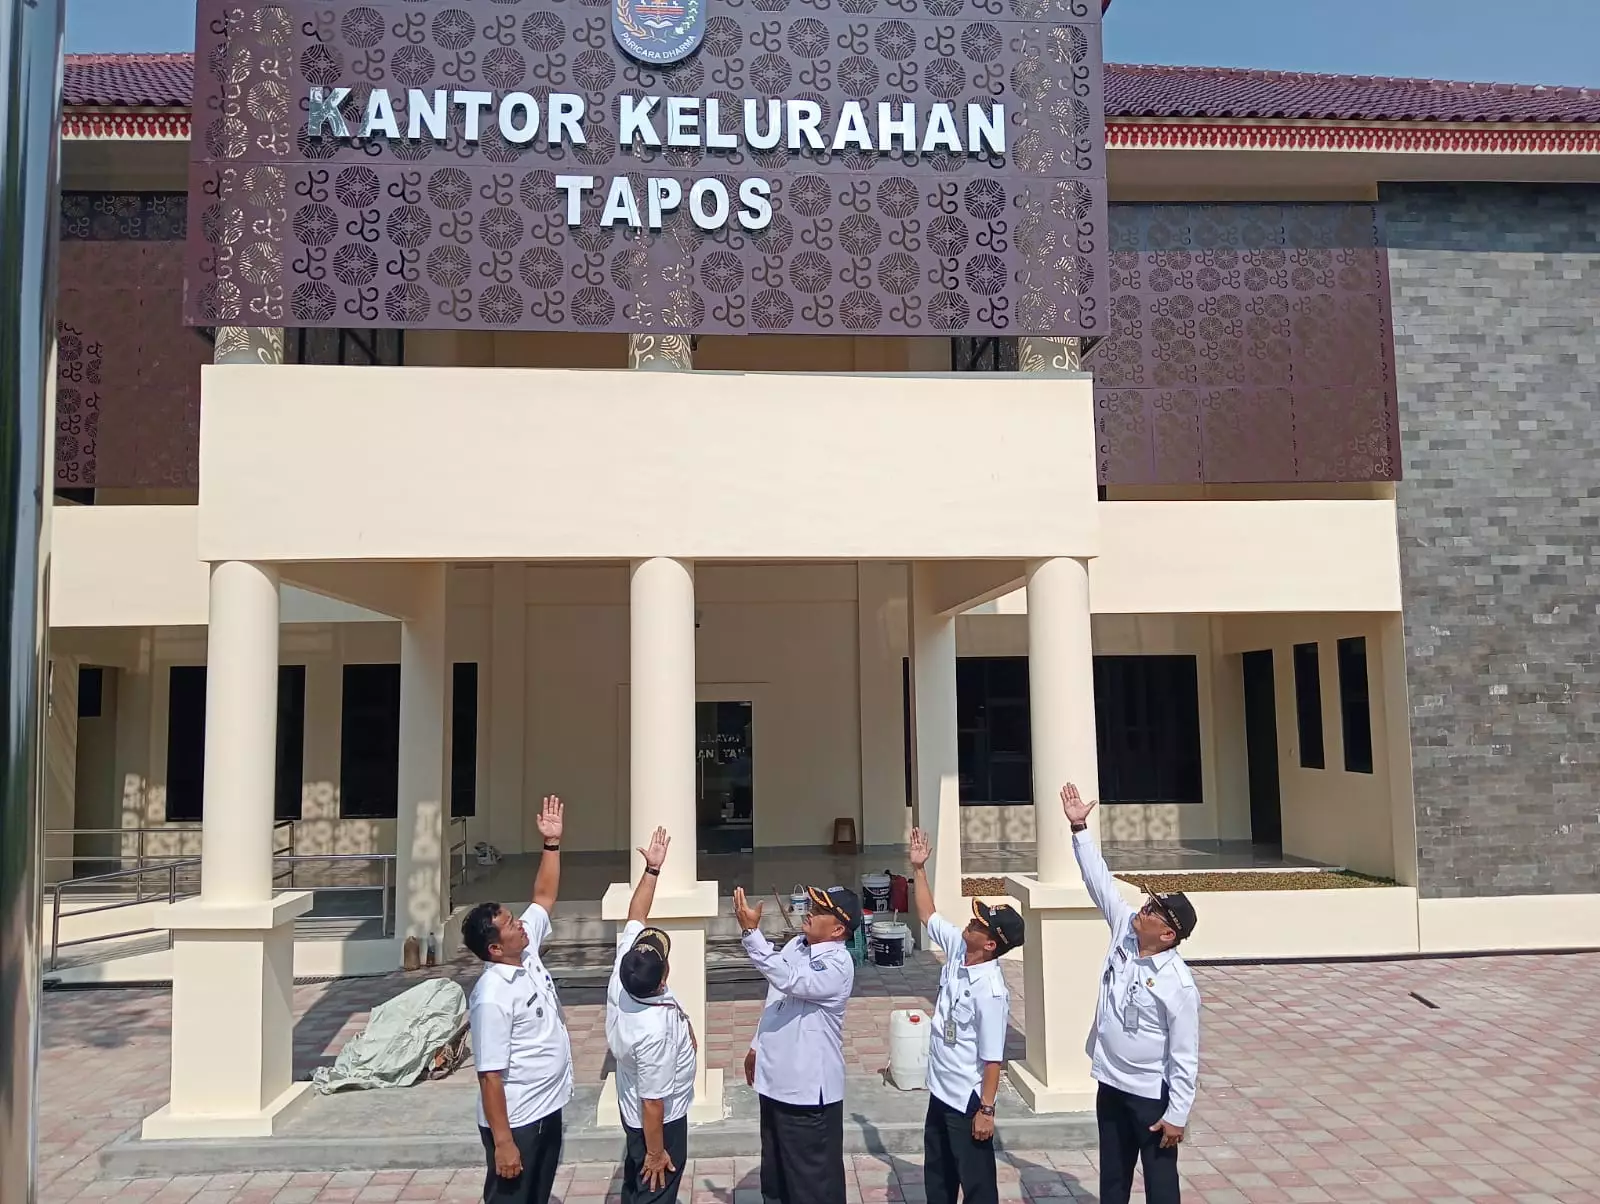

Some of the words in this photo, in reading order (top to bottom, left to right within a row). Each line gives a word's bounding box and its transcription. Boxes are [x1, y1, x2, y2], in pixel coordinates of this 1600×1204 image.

[620, 32, 661, 59] PARICARA
[662, 35, 696, 59] DHARMA
[307, 86, 588, 145] KANTOR
[618, 94, 1007, 154] KELURAHAN
[554, 174, 774, 231] TAPOS
